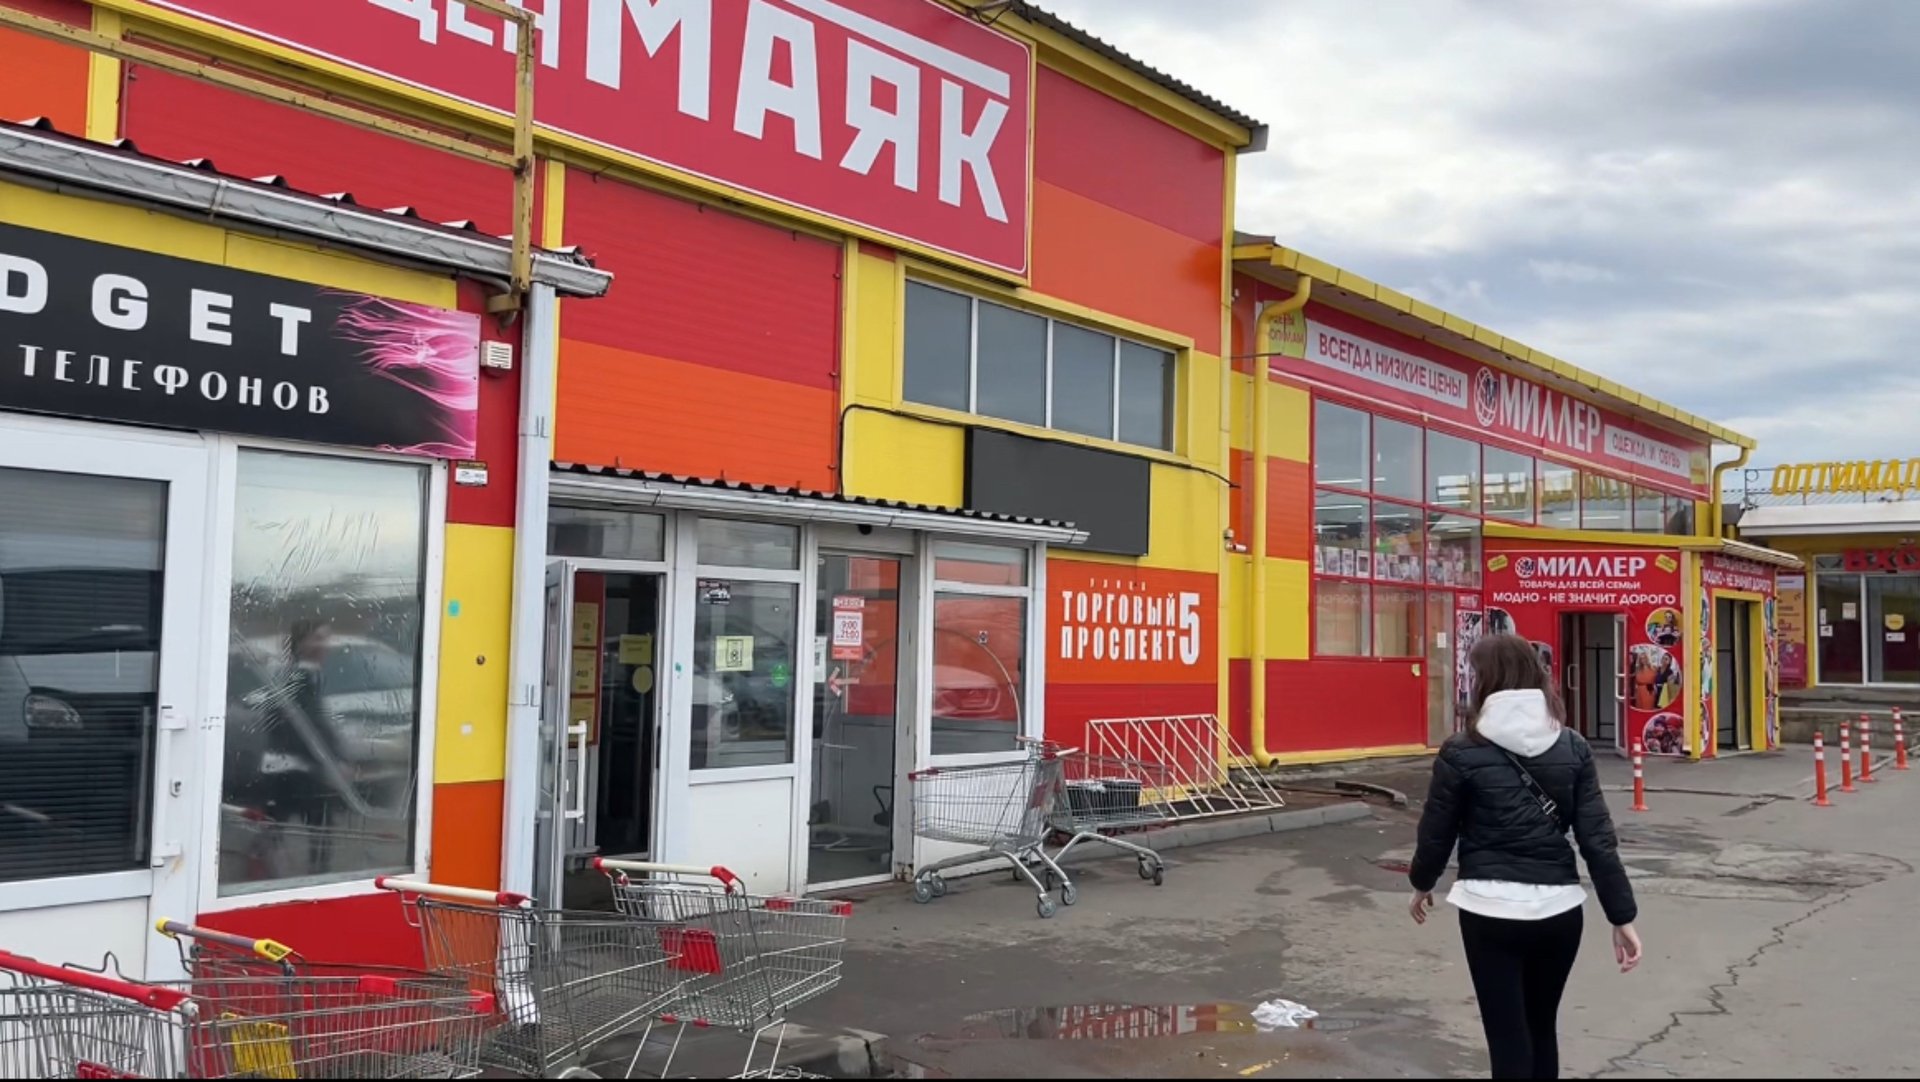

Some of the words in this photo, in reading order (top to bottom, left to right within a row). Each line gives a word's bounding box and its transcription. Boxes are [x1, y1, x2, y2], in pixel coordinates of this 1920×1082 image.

[18, 344, 330, 414] ТЕЛЕФОНОВ
[1319, 332, 1373, 372] ВСЕГДА
[1375, 355, 1427, 387] НИЗКИЕ
[1427, 366, 1462, 399] ЦЕНЫ
[1499, 372, 1601, 454] МИЛЛЕР
[1518, 580, 1557, 589] ТОВАРЫ
[1558, 581, 1578, 590] ДЛЯ
[1579, 579, 1605, 589] ВСЕЙ
[1606, 580, 1641, 590] СЕМЬИ
[1537, 556, 1647, 578] МИЛЛЕР
[1493, 592, 1540, 604] МОДНО
[1548, 592, 1566, 604] НЕ
[1567, 592, 1617, 604] ЗНАЧИТ
[1619, 593, 1676, 606] ДОРОГО
[1060, 625, 1176, 661] ПРОСПЕКТ
[1061, 590, 1177, 627] ТОРГОВЫЙ
[1178, 591, 1201, 666] 5
